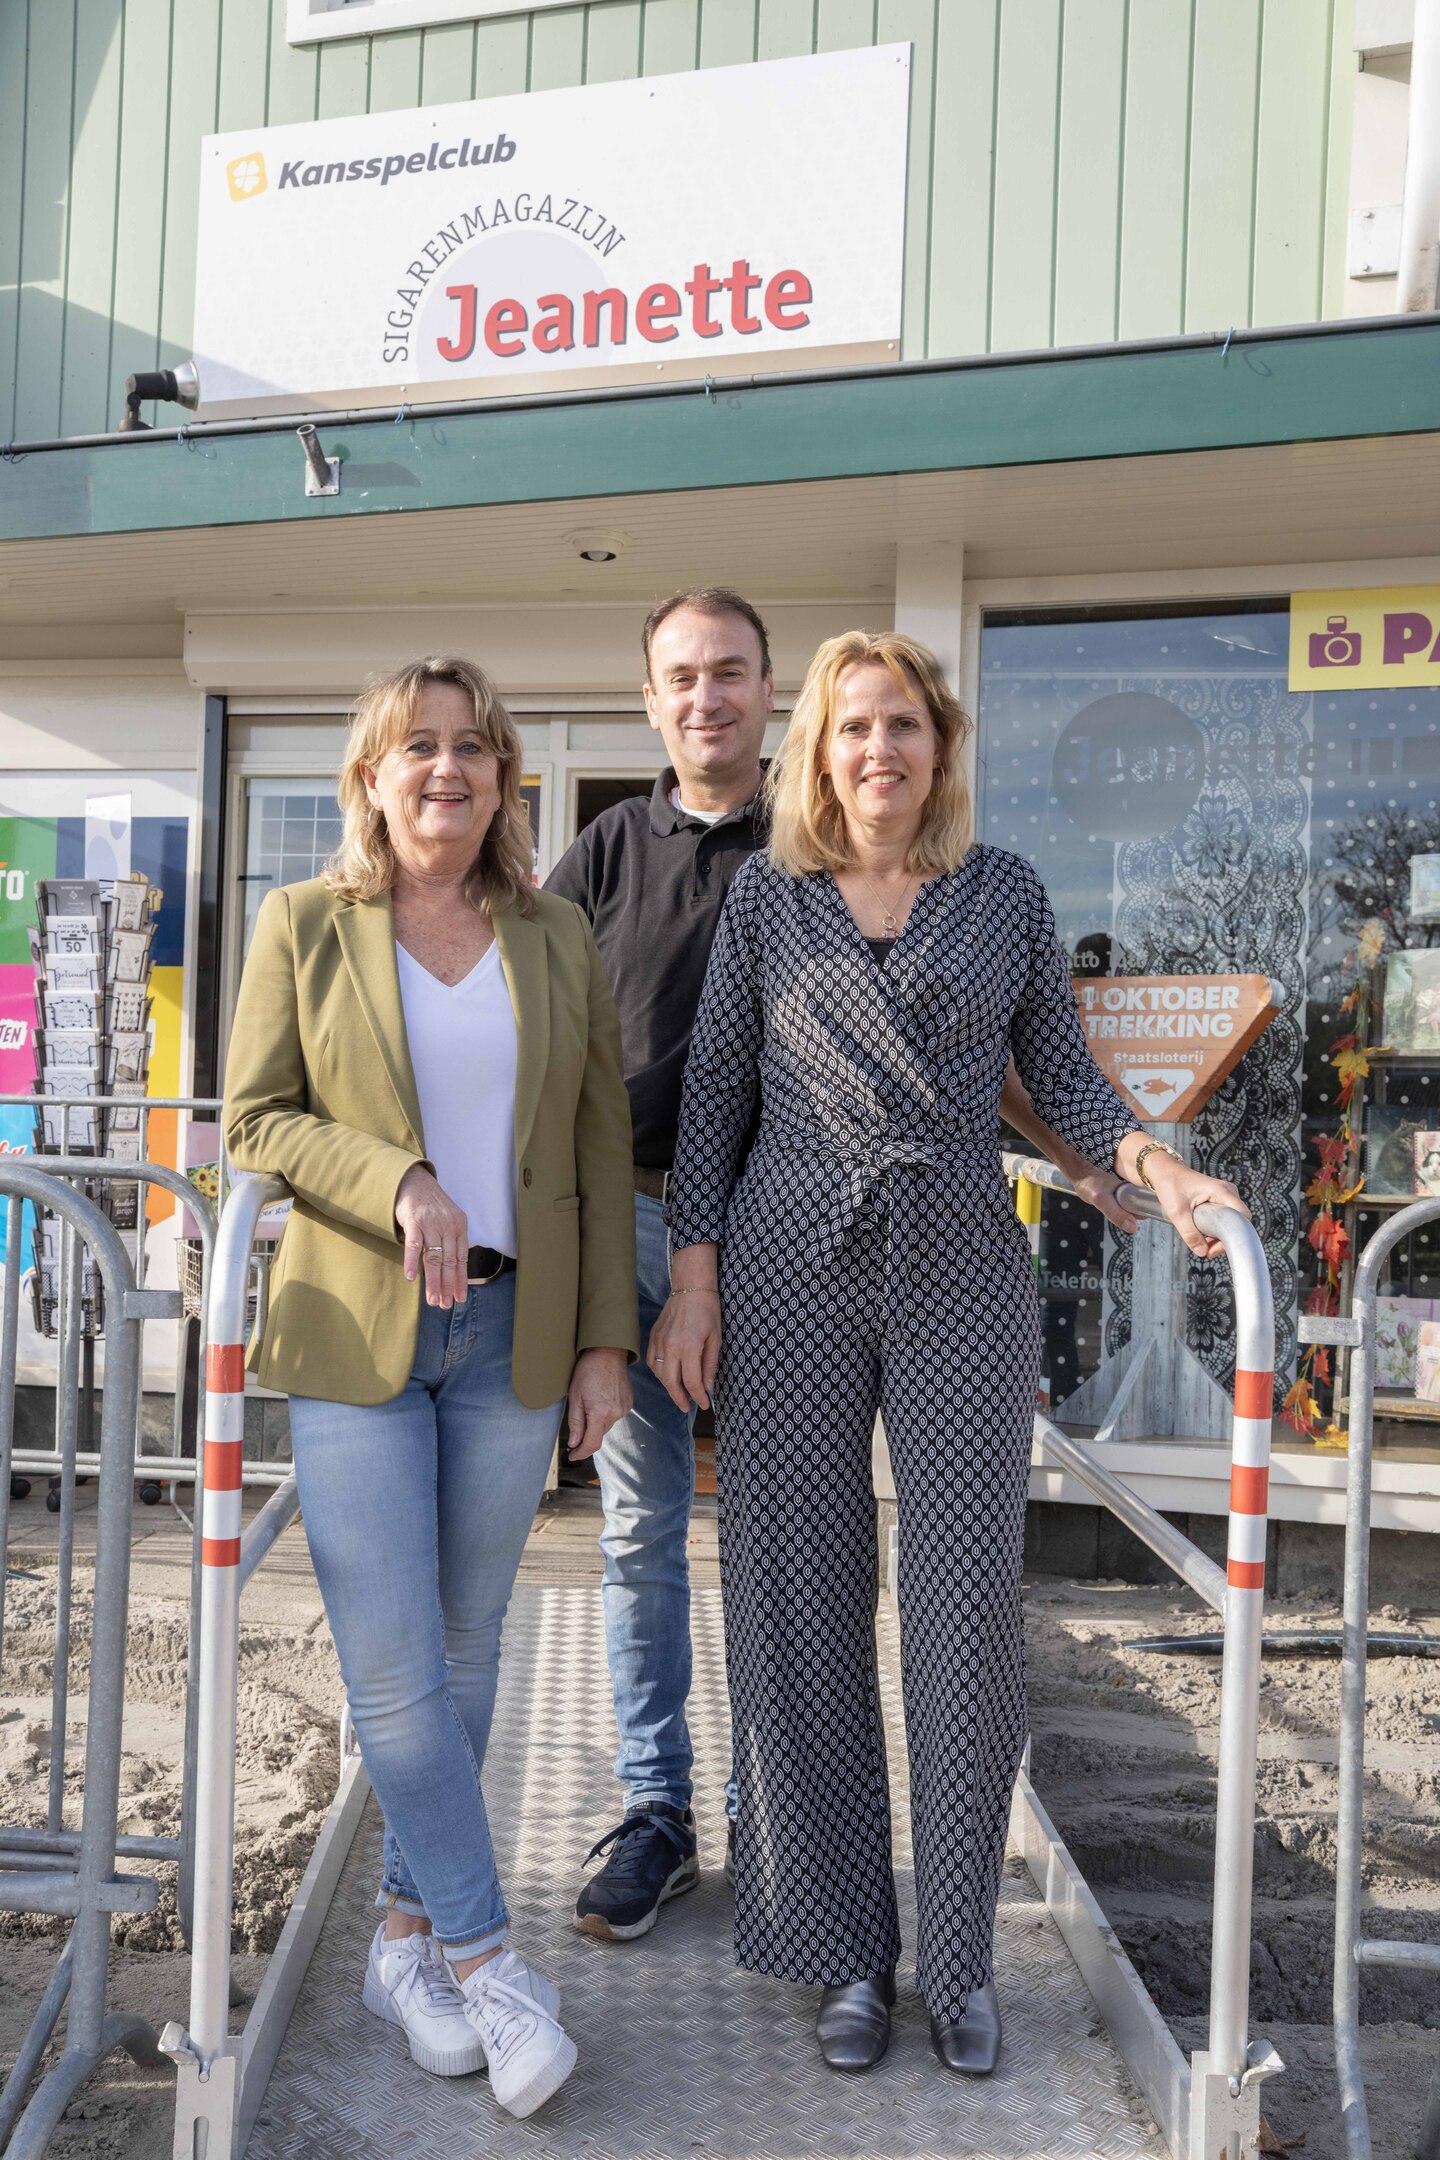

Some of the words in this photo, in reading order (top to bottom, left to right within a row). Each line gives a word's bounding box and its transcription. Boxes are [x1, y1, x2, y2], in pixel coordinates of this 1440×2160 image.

[278, 134, 516, 191] Kansspelclub
[382, 193, 626, 363] SIGARENMAGAZIJN
[436, 258, 813, 363] Jeanette
[1382, 612, 1440, 665] P
[65, 941, 82, 953] 50
[1103, 986, 1240, 1011] OKTOBER
[1085, 1013, 1234, 1038] TREKKING
[1113, 1050, 1204, 1066] Staatsloterij
[1041, 1271, 1197, 1293] Telefoonkten
